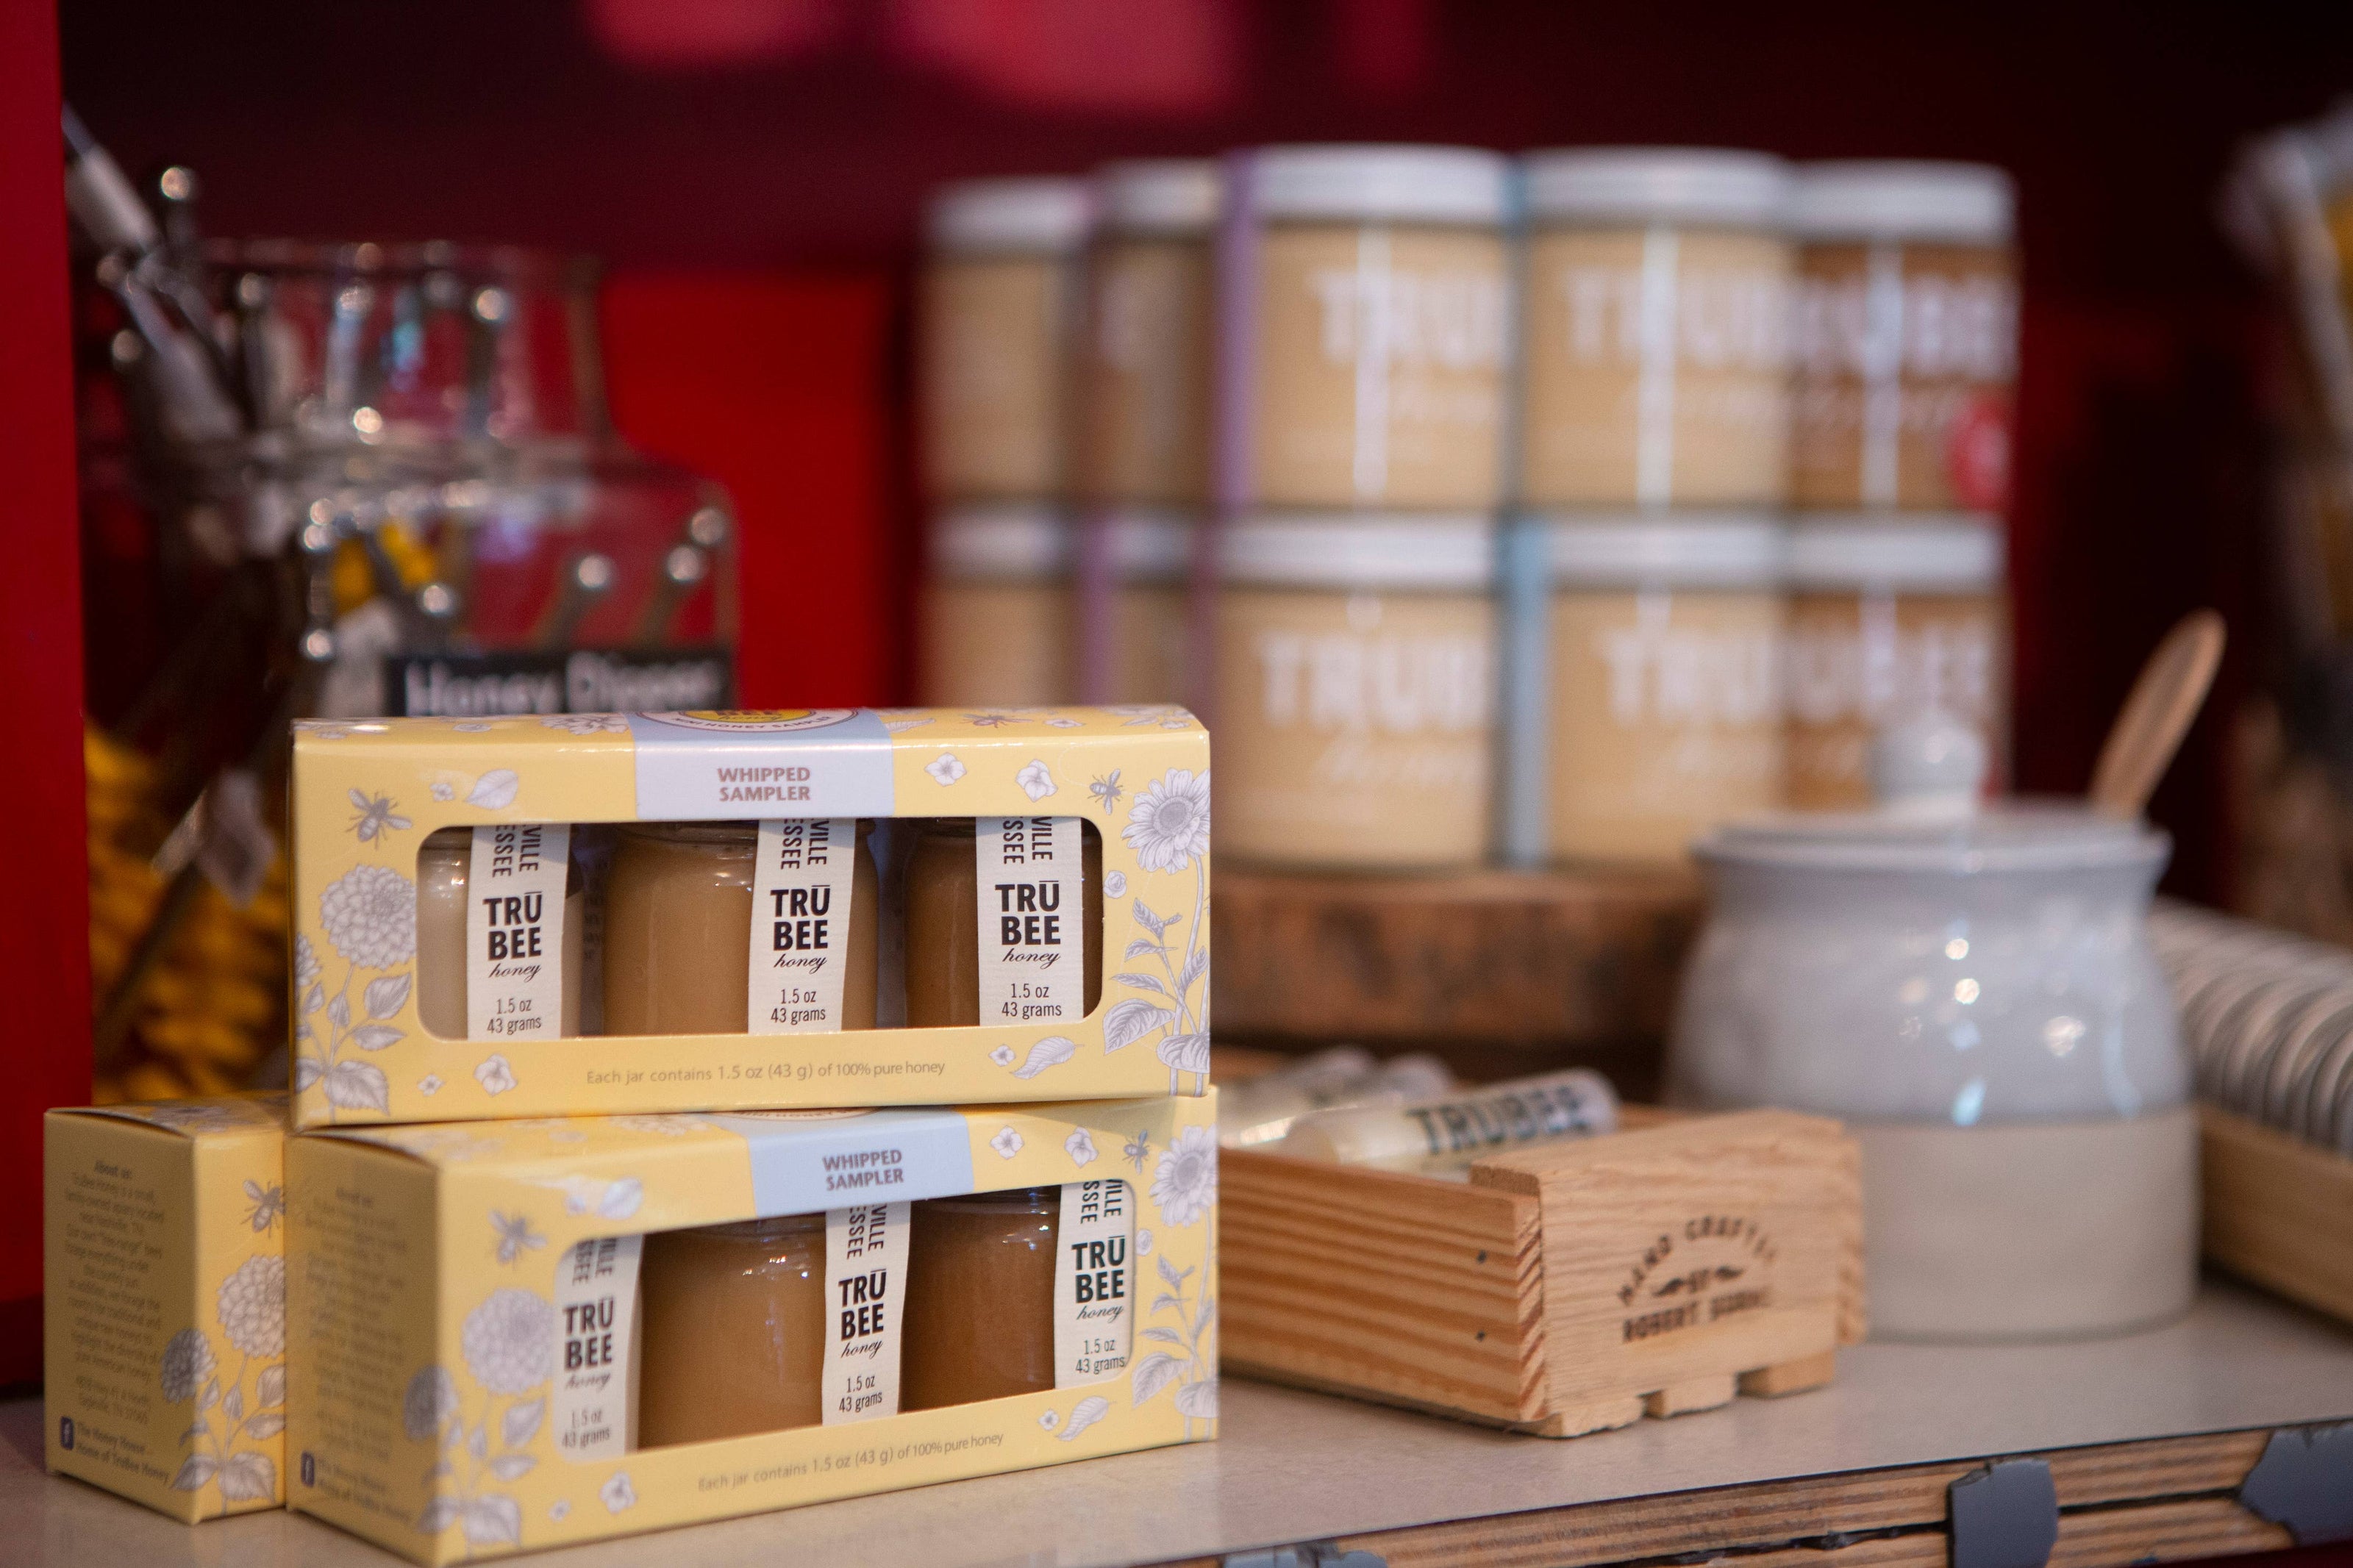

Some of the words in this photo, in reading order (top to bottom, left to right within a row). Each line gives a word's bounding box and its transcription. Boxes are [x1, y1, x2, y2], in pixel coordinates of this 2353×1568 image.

[718, 767, 810, 783] WHIPPED
[718, 787, 811, 802] SAMPLER
[518, 824, 542, 872] VILLE
[807, 818, 829, 865] VILLE
[773, 919, 829, 951] BEE
[1001, 915, 1062, 945] BEE
[488, 926, 543, 962] BEE
[773, 953, 828, 973] honey
[1002, 949, 1061, 969] honey
[488, 962, 542, 983] honey
[780, 989, 801, 1004] 1.5
[804, 990, 817, 1003] oz
[1010, 984, 1032, 999] 1.5
[1035, 985, 1050, 998] oz
[496, 998, 516, 1014] 1.5
[519, 998, 532, 1013] oz
[771, 1008, 786, 1023] 43
[791, 1008, 826, 1025] grams
[1001, 1002, 1019, 1017] 43
[1023, 1003, 1063, 1019] grams
[487, 1018, 503, 1034] 43
[507, 1016, 543, 1036] grams
[587, 1071, 621, 1084] Each
[625, 1070, 643, 1086] jar
[650, 1070, 712, 1082] contains
[718, 1065, 740, 1080] 1.5
[746, 1067, 764, 1079] oz
[768, 1064, 791, 1080] (43
[796, 1064, 813, 1081] g)
[818, 1064, 833, 1077] of
[837, 1063, 871, 1077] 100%
[874, 1063, 902, 1078] pure
[905, 1061, 946, 1075] honey
[822, 1150, 902, 1173] WHIPPED
[826, 1169, 904, 1191] SAMPLER
[868, 1204, 887, 1251] VILLE
[1075, 1270, 1125, 1304] BEE
[840, 1303, 885, 1341] BEE
[1076, 1305, 1124, 1322] honey
[564, 1333, 613, 1371] BEE
[840, 1339, 884, 1358] honey
[1083, 1339, 1101, 1355] 1.5
[1104, 1338, 1115, 1351] oz
[1076, 1358, 1090, 1374] 43
[1093, 1355, 1126, 1375] grams
[846, 1377, 863, 1394] 1.5
[865, 1375, 876, 1389] oz
[838, 1397, 854, 1413] 43
[854, 1392, 883, 1413] grams
[579, 1426, 610, 1450] grams
[699, 1473, 729, 1491] Each
[732, 1471, 749, 1489] jar
[754, 1463, 807, 1482] contains
[813, 1456, 832, 1472] 1.5
[835, 1456, 851, 1469] oz
[855, 1450, 876, 1467] (43
[879, 1447, 894, 1466] g)
[898, 1445, 911, 1460] of
[914, 1442, 942, 1457] 100%
[945, 1439, 968, 1456] pure
[971, 1433, 1004, 1447] honey
